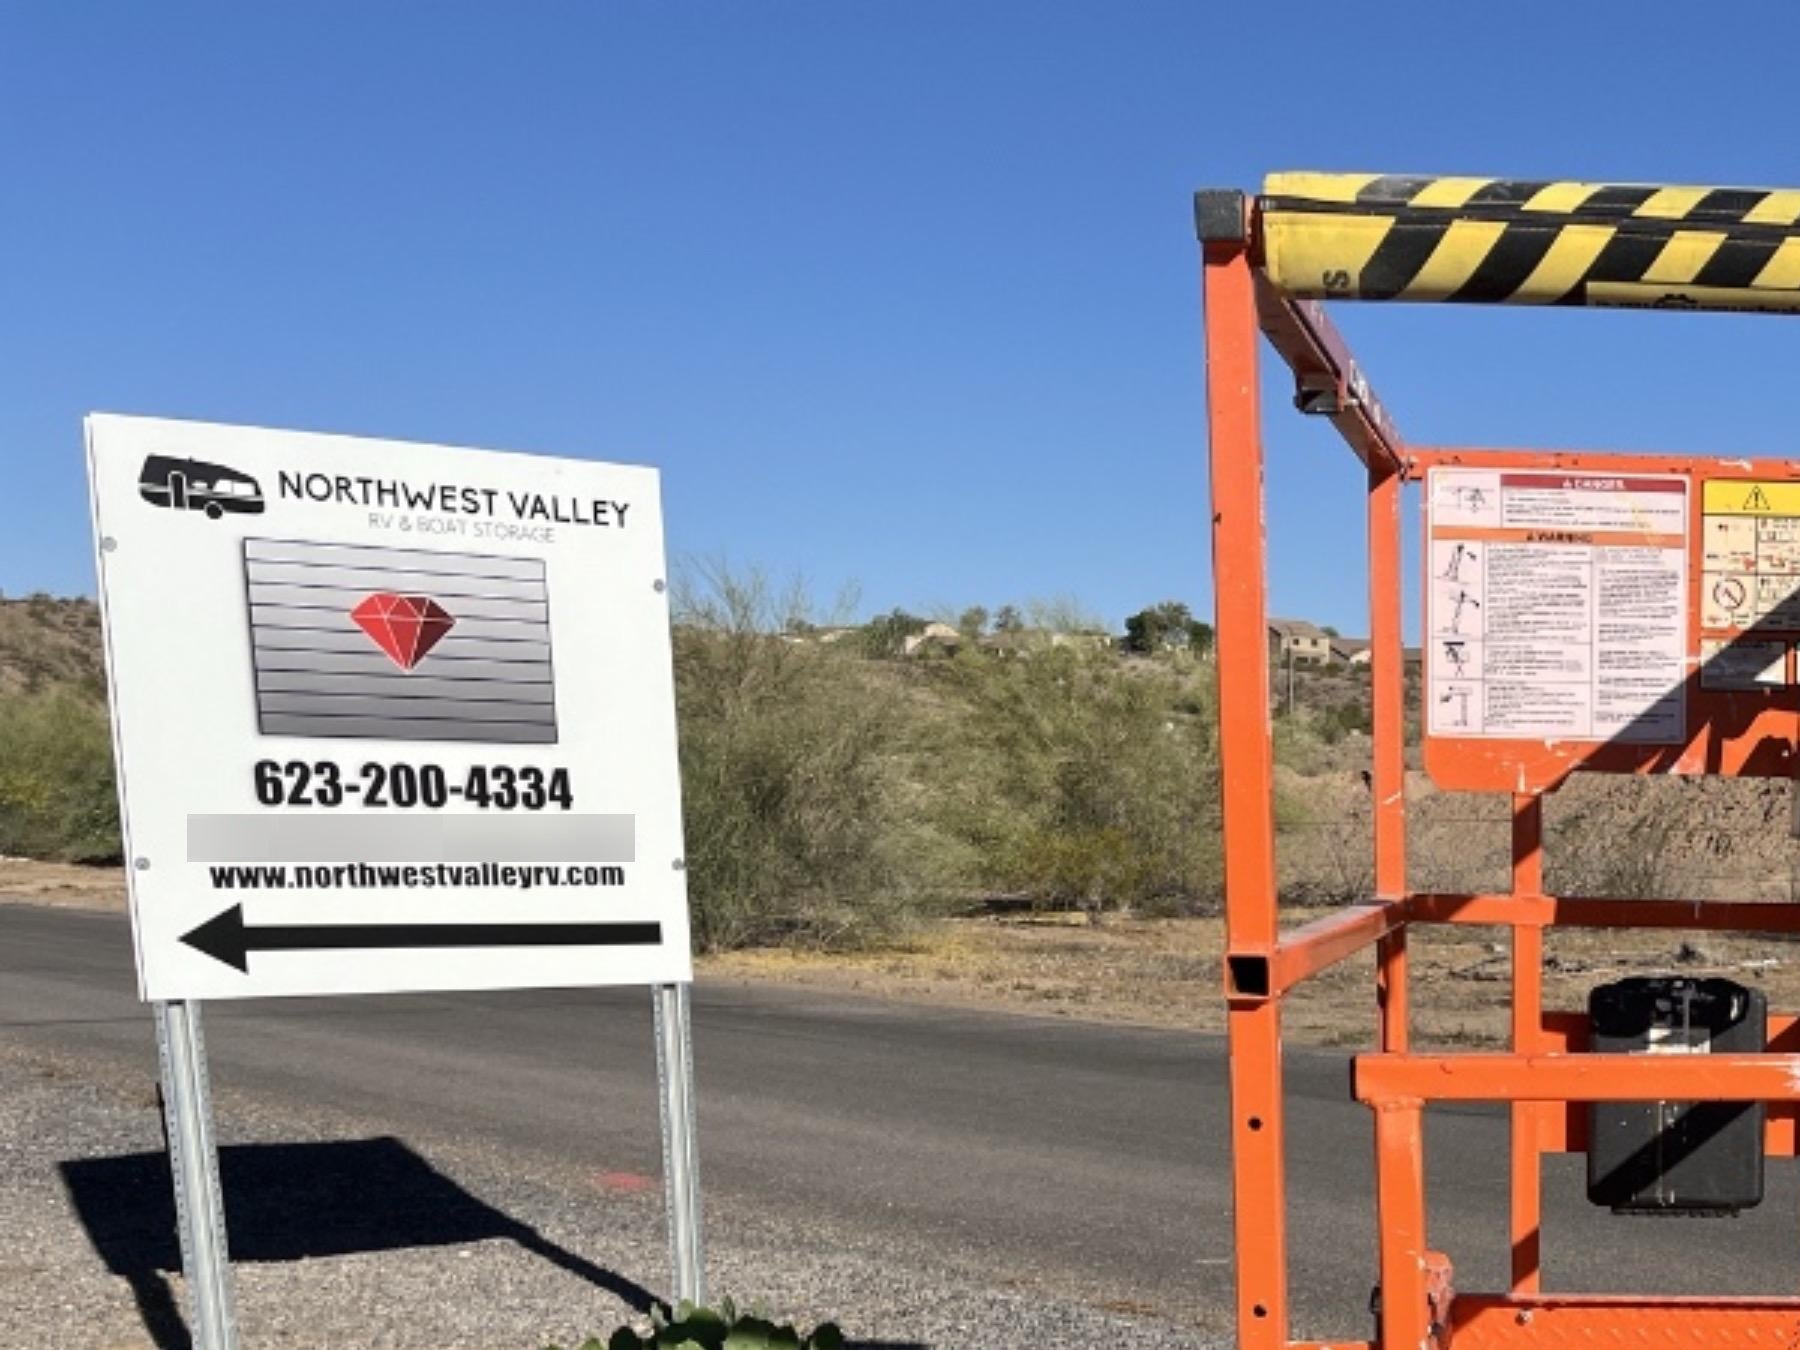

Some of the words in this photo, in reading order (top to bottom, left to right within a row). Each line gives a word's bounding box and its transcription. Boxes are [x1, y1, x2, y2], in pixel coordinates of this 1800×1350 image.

[278, 471, 498, 516] NORTHWEST
[506, 490, 630, 528] VALLEY
[368, 512, 392, 528] RV
[398, 514, 413, 532] &
[416, 515, 467, 536] BOAT
[473, 520, 557, 543] STORAGE
[253, 758, 575, 811] 623-200-4334
[209, 862, 626, 890] www.northwestvalleyrv.com
